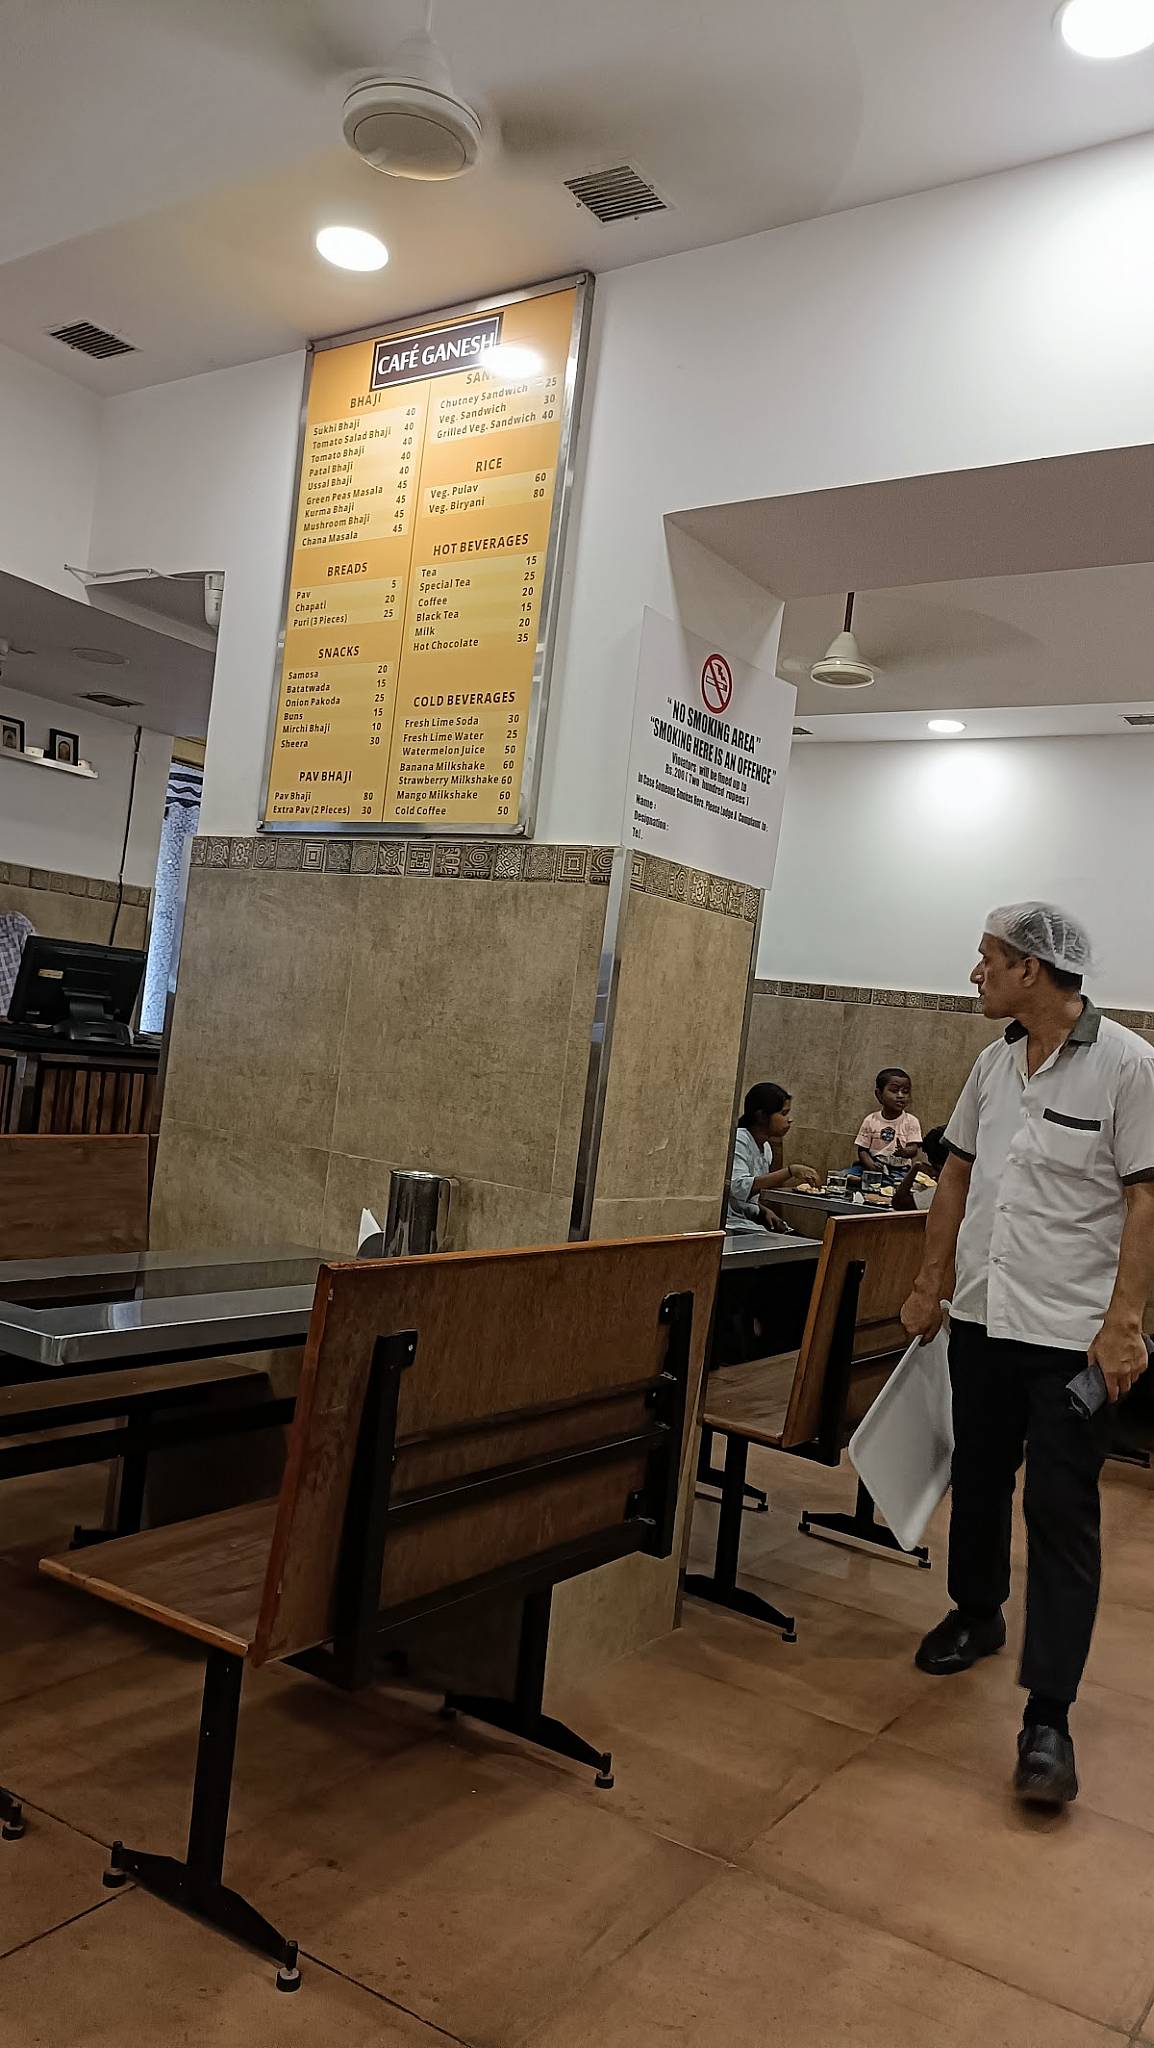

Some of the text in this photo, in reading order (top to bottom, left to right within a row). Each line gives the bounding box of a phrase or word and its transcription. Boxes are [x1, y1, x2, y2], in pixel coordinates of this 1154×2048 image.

[378, 332, 495, 375] CAFÉ GANESH
[351, 393, 381, 408] BHAJI
[440, 377, 557, 409] Chutney Sandwich 25
[440, 394, 555, 424] Veg. Sandwich 30
[313, 408, 415, 435] Sukhi Bhaji 40
[437, 410, 553, 438] Grilled Veg. Sandwich 40
[312, 422, 414, 449] Tomato Salad Bhaji 40
[311, 437, 412, 463] Tomato Bhaji 40
[309, 452, 410, 477] Patal Bhaji 40
[476, 458, 502, 472] RICE
[308, 466, 409, 490] Ussal Bhaji 40
[431, 473, 546, 499] Veg. Pulav 60
[307, 480, 407, 505] Green Peas Masala 45
[429, 489, 544, 514] Veg. Biryani 80
[305, 495, 405, 518] Kurma Bhaji 45
[304, 510, 404, 531] Mushroom Bhaji 45
[302, 524, 402, 546] Chana Masala 45
[433, 534, 528, 556] HOT BEVERAGES
[328, 562, 368, 576] BREADS
[422, 556, 536, 577] Tea 15
[392, 580, 396, 588] 5
[420, 572, 535, 593] Special Tea 25
[295, 595, 395, 612] Chapati 20
[418, 587, 533, 607] Coffee 20
[320, 614, 347, 624] Pieces)
[384, 609, 393, 617] 25
[417, 603, 532, 621] Black Tea 15
[415, 618, 530, 636] Milk 20
[413, 633, 528, 651] Hot Chocolate 35
[318, 646, 359, 658] SNACKS
[288, 665, 387, 679] Samosa 20
[287, 679, 386, 693] Batatwada 15
[286, 694, 384, 707] Onion Pakoda 25
[414, 692, 515, 707] COLD BEVERAGES
[374, 708, 383, 716] 15
[405, 715, 519, 727] Fresh Lime Soda 30
[283, 724, 307, 733] Mirchi
[310, 724, 330, 734] Bhaji
[688, 707, 730, 743] SMOKING
[281, 737, 380, 748] Sheera 30
[403, 730, 517, 742] Fresh Lime Water 25
[403, 745, 516, 756] Watermelon Juice 50
[693, 737, 712, 762] HERE
[714, 747, 723, 766] IS
[724, 752, 735, 771] AN
[400, 760, 514, 771] Banana Milkshake 60
[300, 771, 352, 783] PAV BHAJI
[399, 775, 512, 786] Strawberry Milkshake 60
[644, 774, 654, 788] Case
[699, 766, 709, 778] will
[711, 769, 717, 780] be
[733, 778, 740, 790] up
[741, 782, 747, 792] to
[275, 792, 373, 802] Pav Bhaji 80
[397, 790, 510, 801] Mango Milkshake 60
[689, 773, 699, 786] Two
[702, 779, 725, 796] hundred
[726, 790, 745, 805] rupees
[311, 806, 319, 815] (2
[321, 805, 350, 815] Pieces)
[396, 806, 508, 815] Cold Coffee 50
